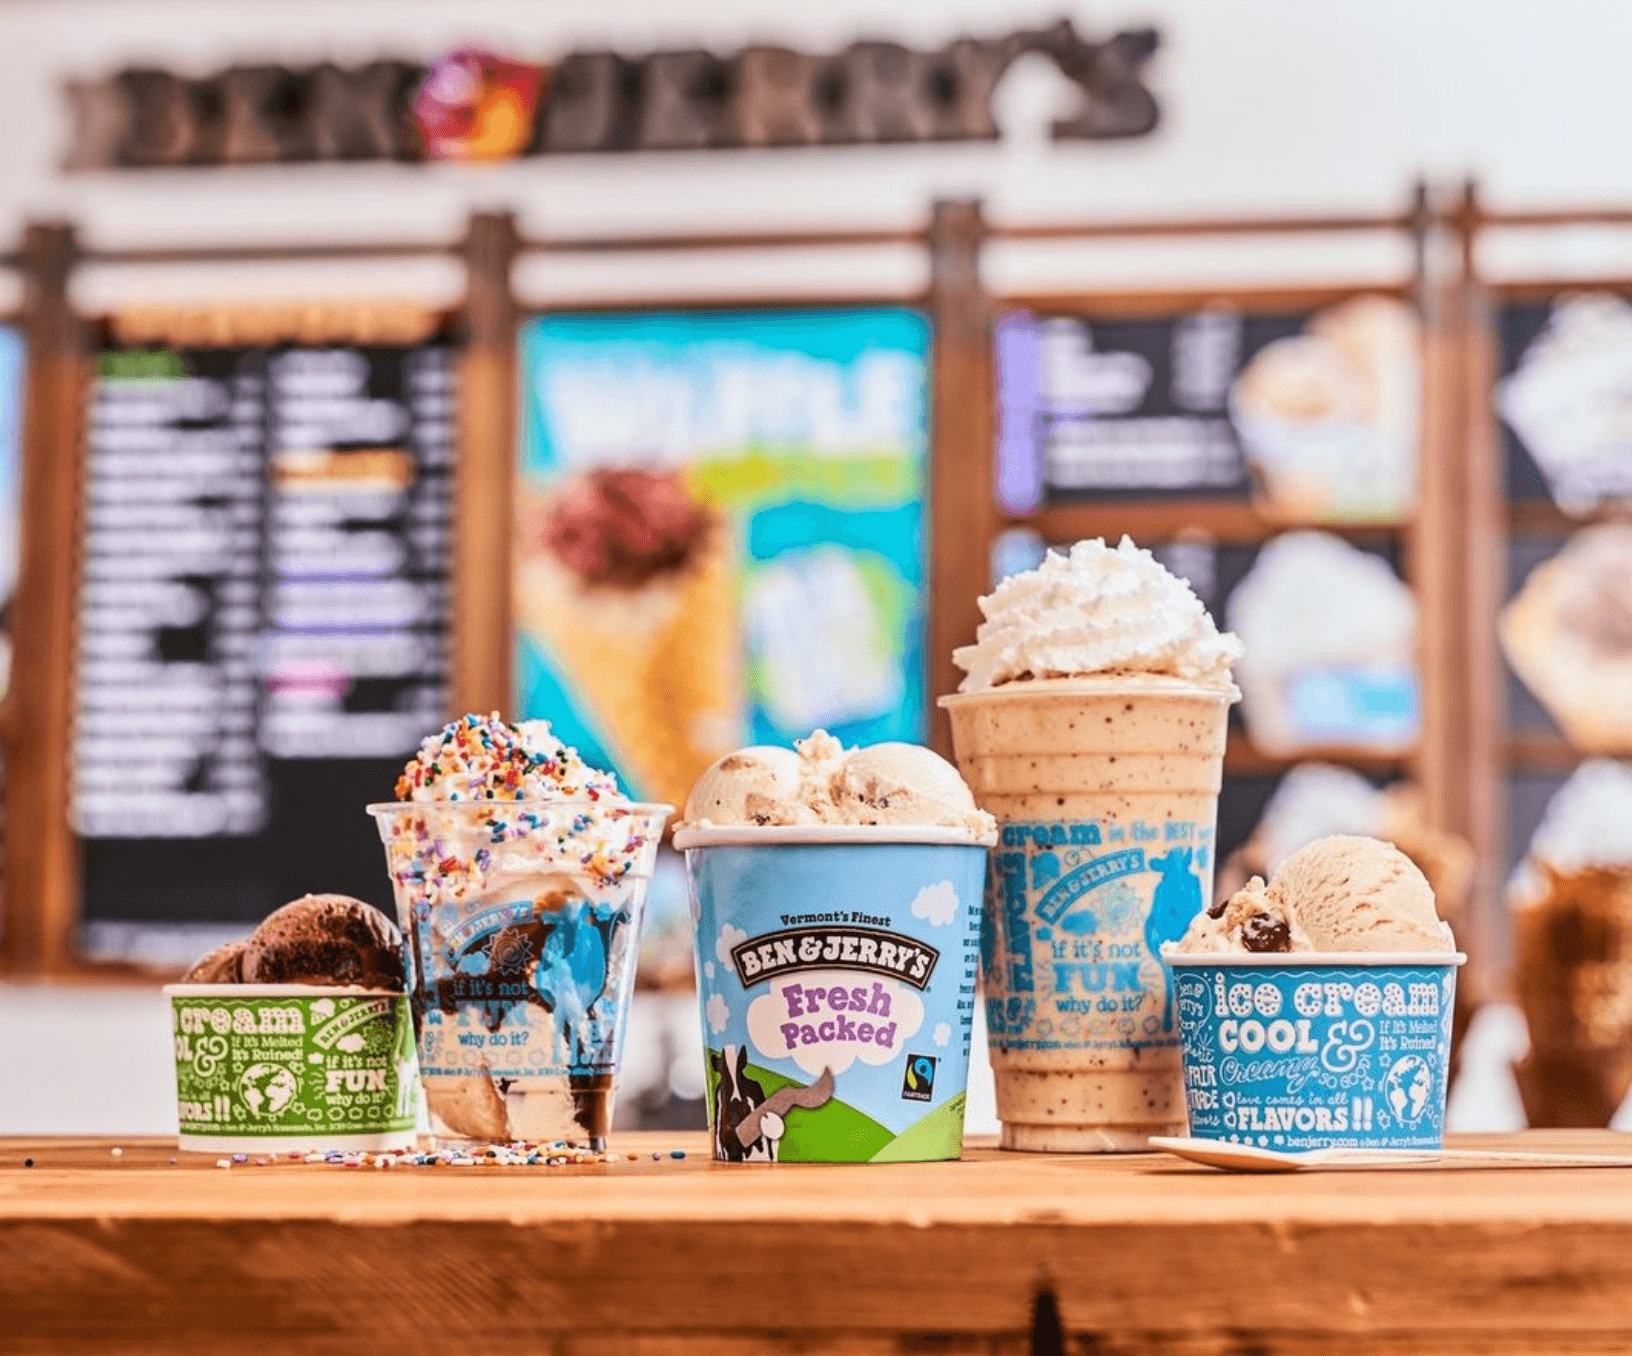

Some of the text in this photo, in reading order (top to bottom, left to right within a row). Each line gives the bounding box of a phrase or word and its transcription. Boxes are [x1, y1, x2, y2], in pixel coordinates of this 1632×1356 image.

[1002, 824, 1102, 846] cream
[780, 911, 891, 927] Vermont's Finest
[740, 935, 930, 979] BEN & JERRY'S
[1052, 940, 1141, 958] if it's not
[453, 978, 530, 996] if it's not
[1053, 962, 1142, 993] FUN
[782, 981, 892, 1019] Fresh
[1056, 993, 1146, 1014] why do it?
[1214, 972, 1439, 1018] ice cream
[181, 1006, 306, 1034] cream
[457, 1031, 485, 1048] why
[489, 1031, 507, 1046] do
[510, 1031, 529, 1046] it?
[780, 1014, 898, 1050] Packed
[194, 1035, 228, 1077] &
[1219, 1019, 1375, 1072] COOL &
[326, 1054, 340, 1069] if
[342, 1054, 364, 1069] it's
[325, 1069, 387, 1093] FUN
[1188, 1065, 1217, 1087] FAIR
[1220, 1056, 1320, 1093] Creamy
[325, 1091, 353, 1107] why
[354, 1092, 371, 1105] do
[1237, 1091, 1348, 1105] love comes in all
